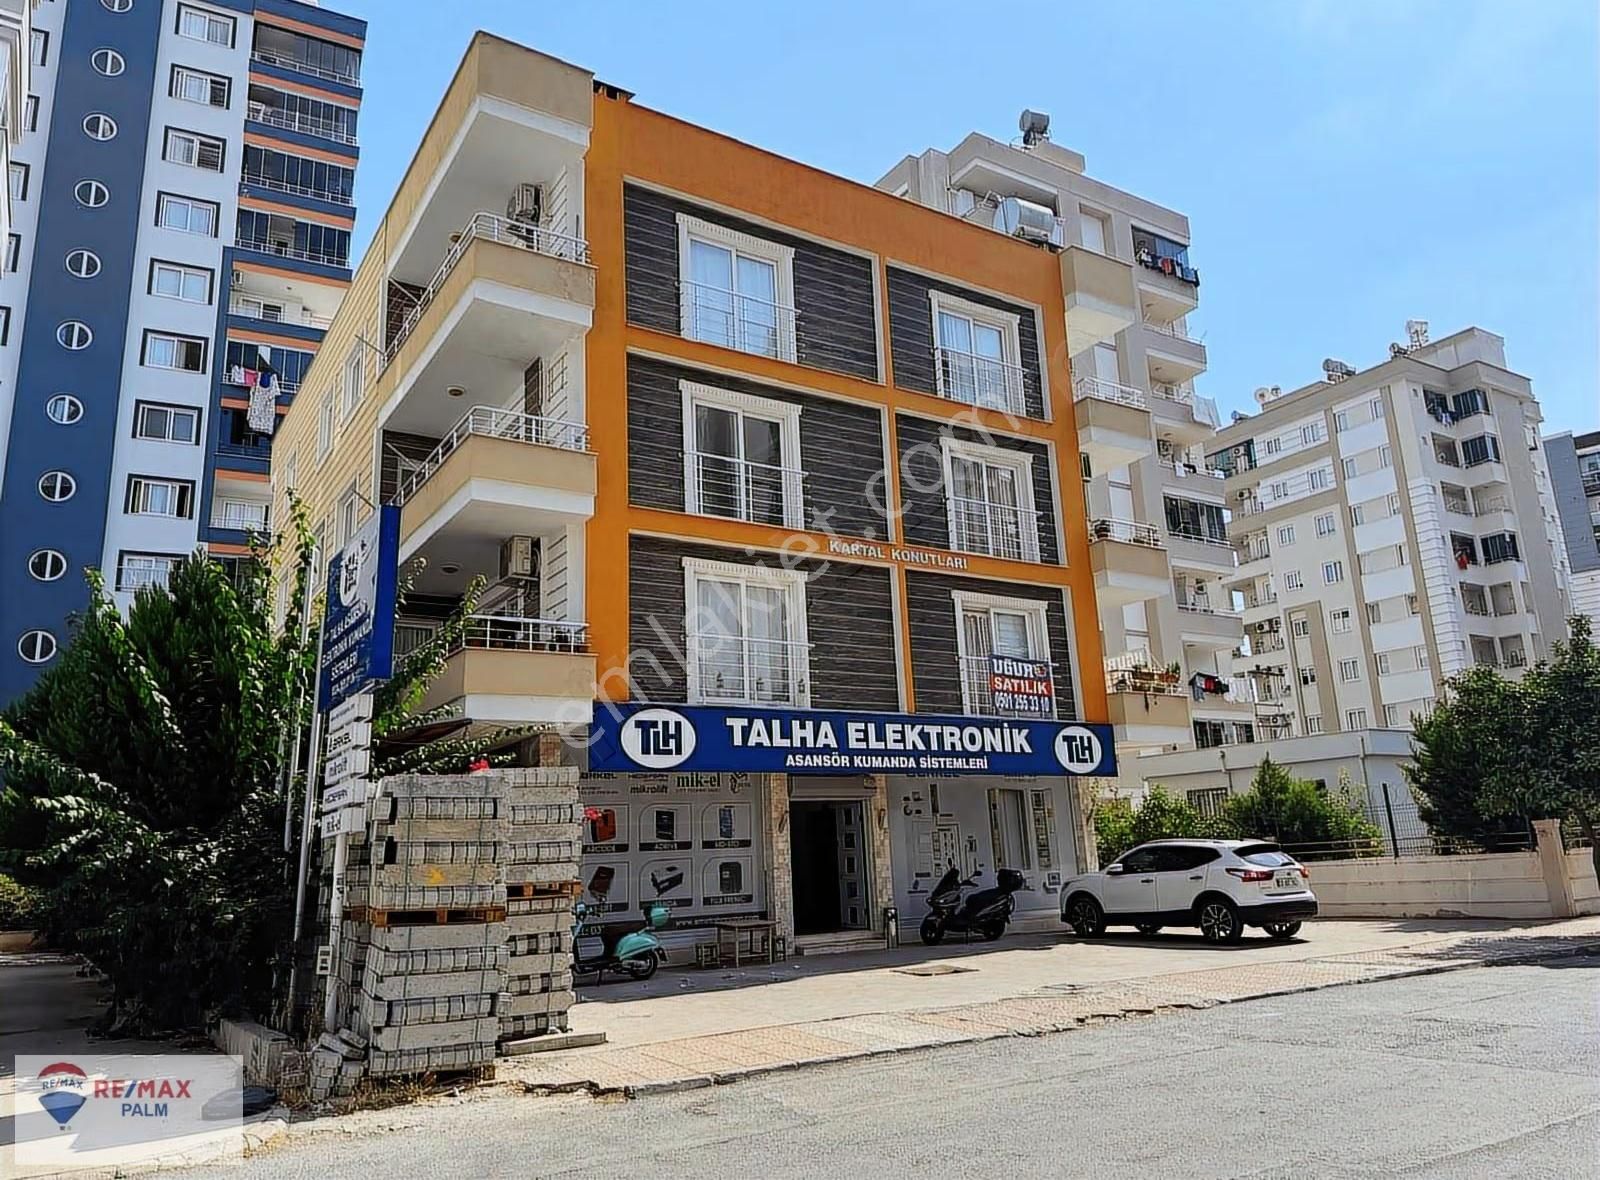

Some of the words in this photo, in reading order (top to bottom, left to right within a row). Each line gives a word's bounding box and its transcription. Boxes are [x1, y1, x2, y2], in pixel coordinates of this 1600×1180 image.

[829, 540, 886, 559] KARTAL
[892, 549, 969, 570] KONUTLARI
[992, 658, 1034, 678] UĞUR
[994, 677, 1049, 695] SATILIK
[634, 720, 684, 757] TLH
[726, 717, 838, 750] TALHA
[847, 721, 1032, 754] ELEKTRONİK
[1062, 735, 1096, 764] TLH
[785, 754, 850, 769] ASANSÖR
[853, 756, 917, 769] KUMANDA
[919, 756, 988, 770] SİSTEMLERİ
[677, 772, 721, 788] mik-el
